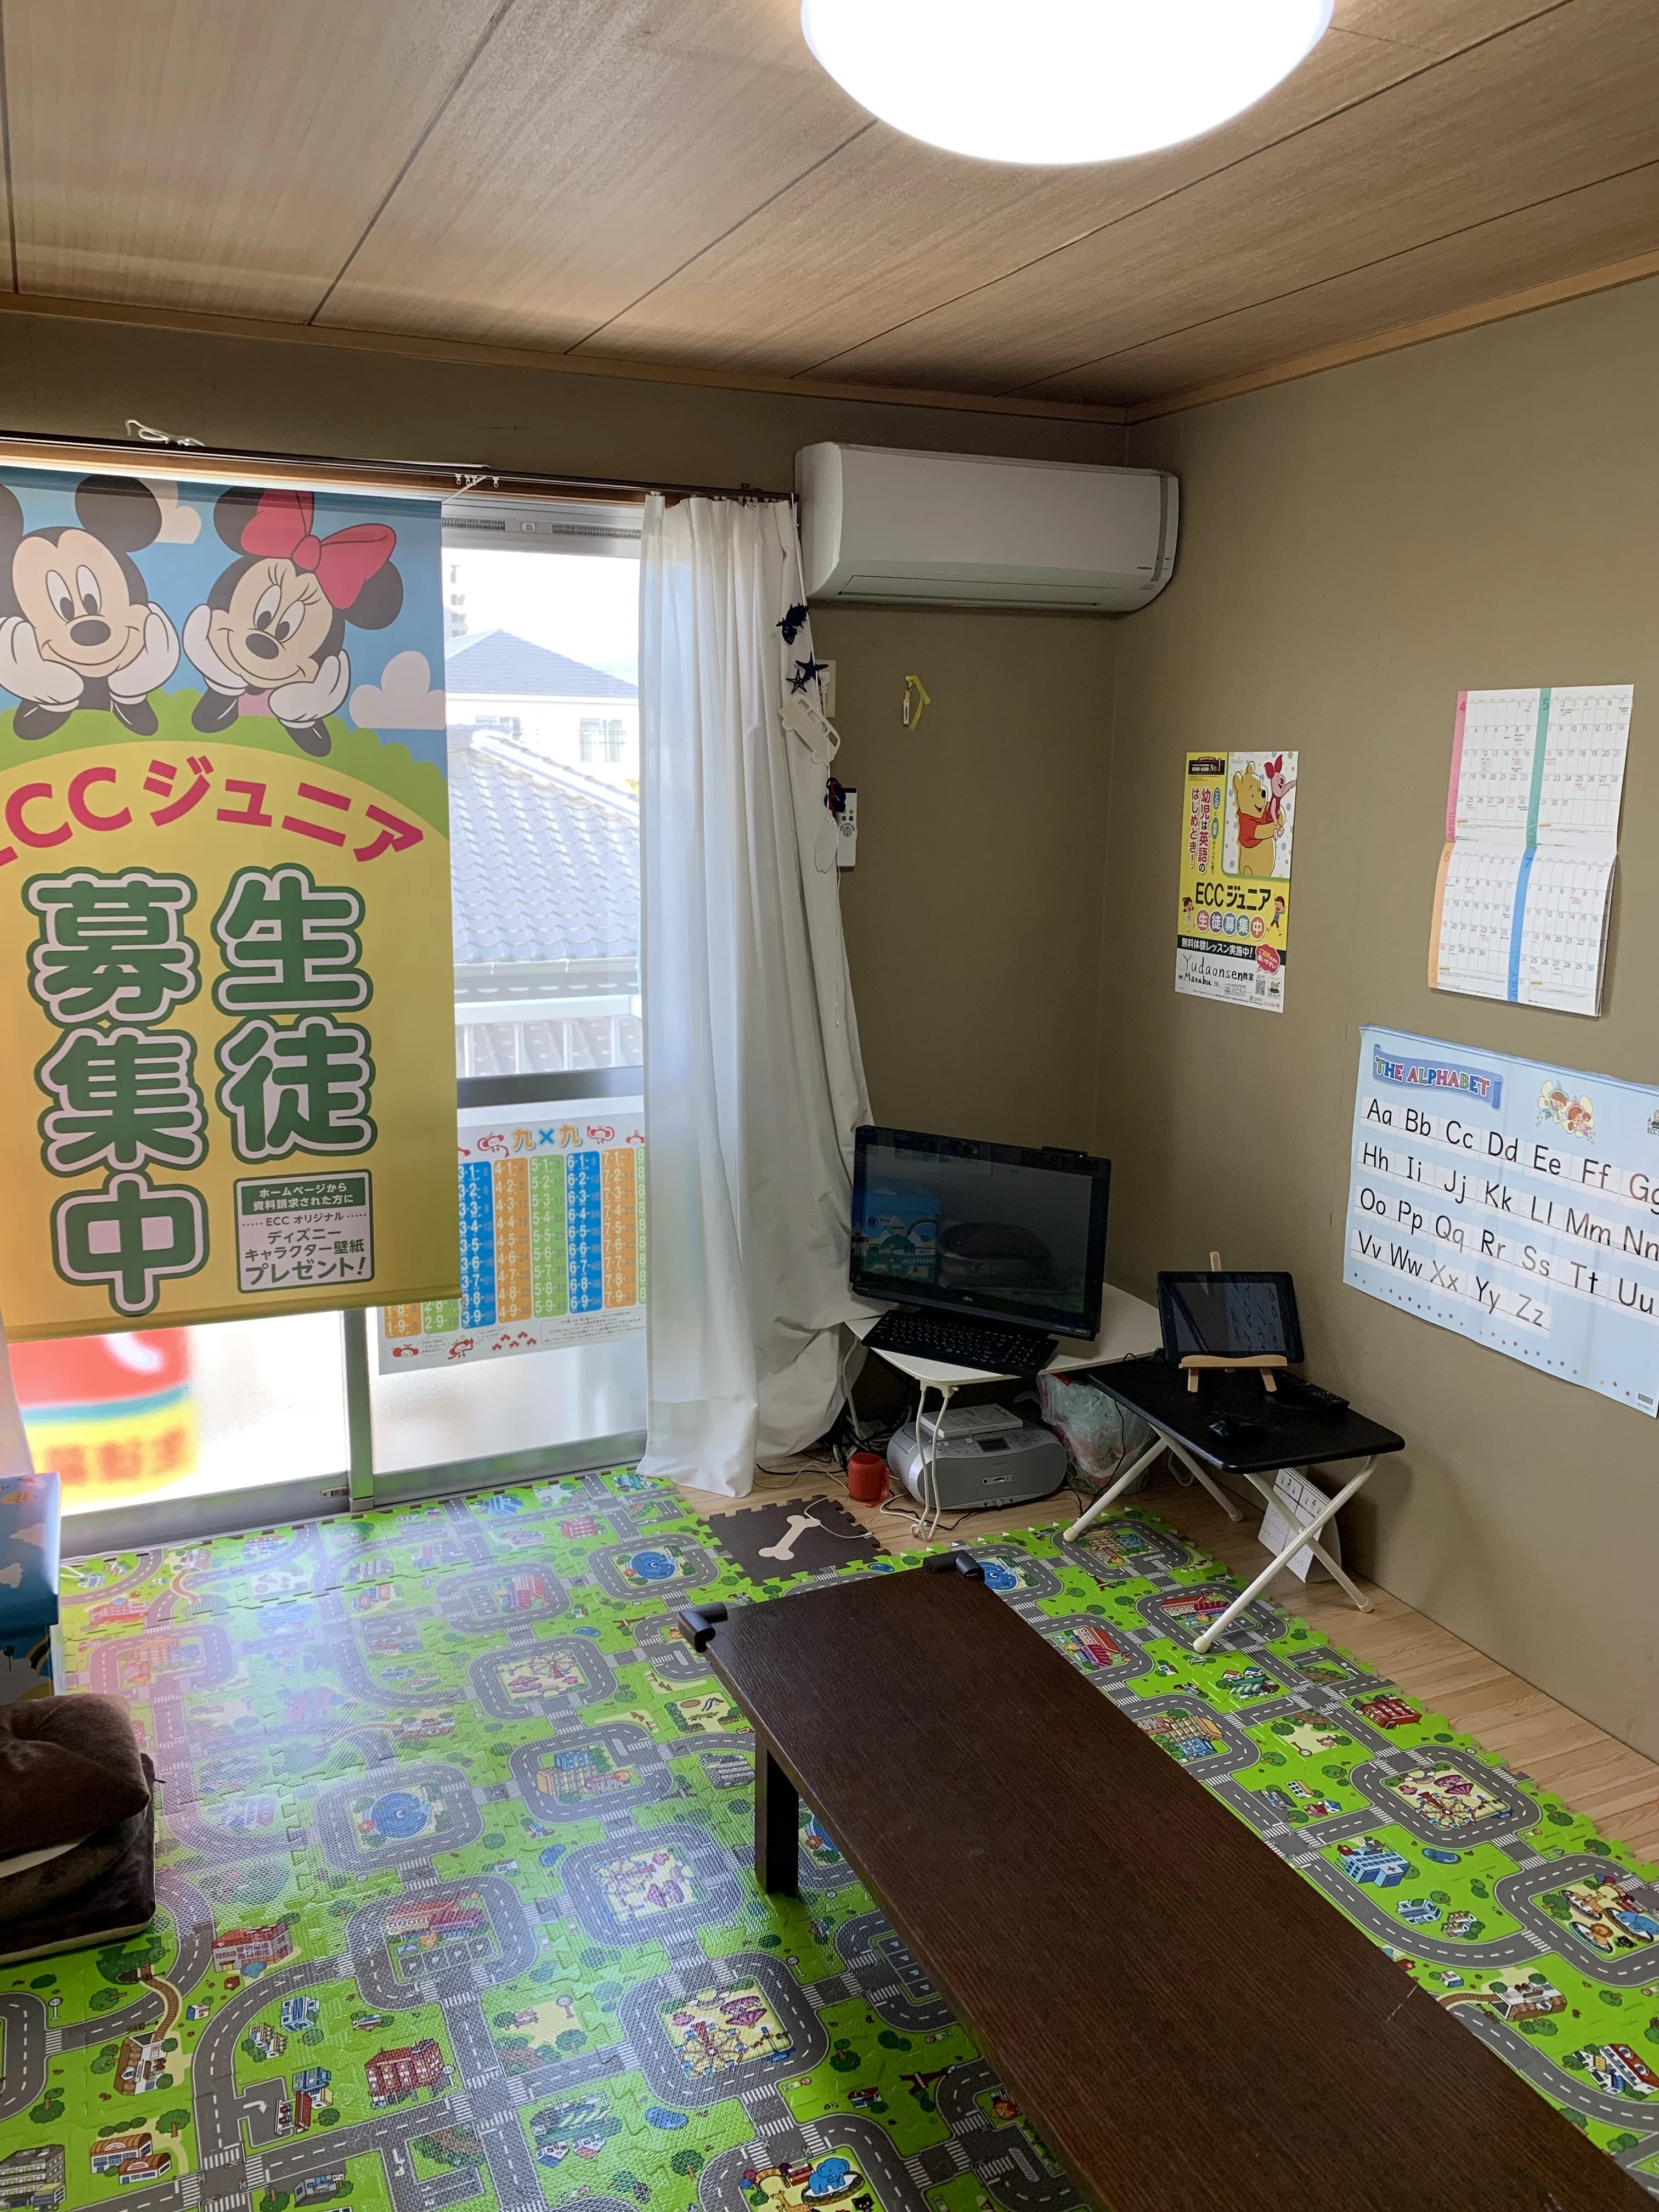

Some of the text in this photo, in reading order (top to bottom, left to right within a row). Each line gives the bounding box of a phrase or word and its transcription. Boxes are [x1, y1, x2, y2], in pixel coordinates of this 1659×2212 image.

[1374, 1056, 1491, 1098] THE ALPHABET
[1367, 1098, 1392, 1127] Aa
[1405, 1108, 1432, 1137] Bb
[1446, 1120, 1474, 1150] Cc
[1488, 1131, 1519, 1161] Dd
[1533, 1145, 1561, 1176] Ee
[1582, 1159, 1612, 1190] Ff
[253, 1194, 353, 1211] 資料請求された方に
[259, 1183, 347, 1198] ホームページから
[1363, 1142, 1390, 1172] Hh
[1406, 1156, 1422, 1181] Ii
[1444, 1170, 1467, 1204] Jj
[1485, 1183, 1513, 1214] Kk
[1531, 1195, 1553, 1227] Ll
[1566, 1207, 1612, 1246] Mm
[266, 1212, 343, 1226] ECC オリジナル
[245, 1239, 364, 1261] キャラクター壁紙
[268, 1228, 341, 1244] ディズニー
[1360, 1187, 1654, 1314] Oo Pp Qq Rr Ss Tt Uu
[1358, 1230, 1544, 1327] Vv Ww Xx Yy Zz
